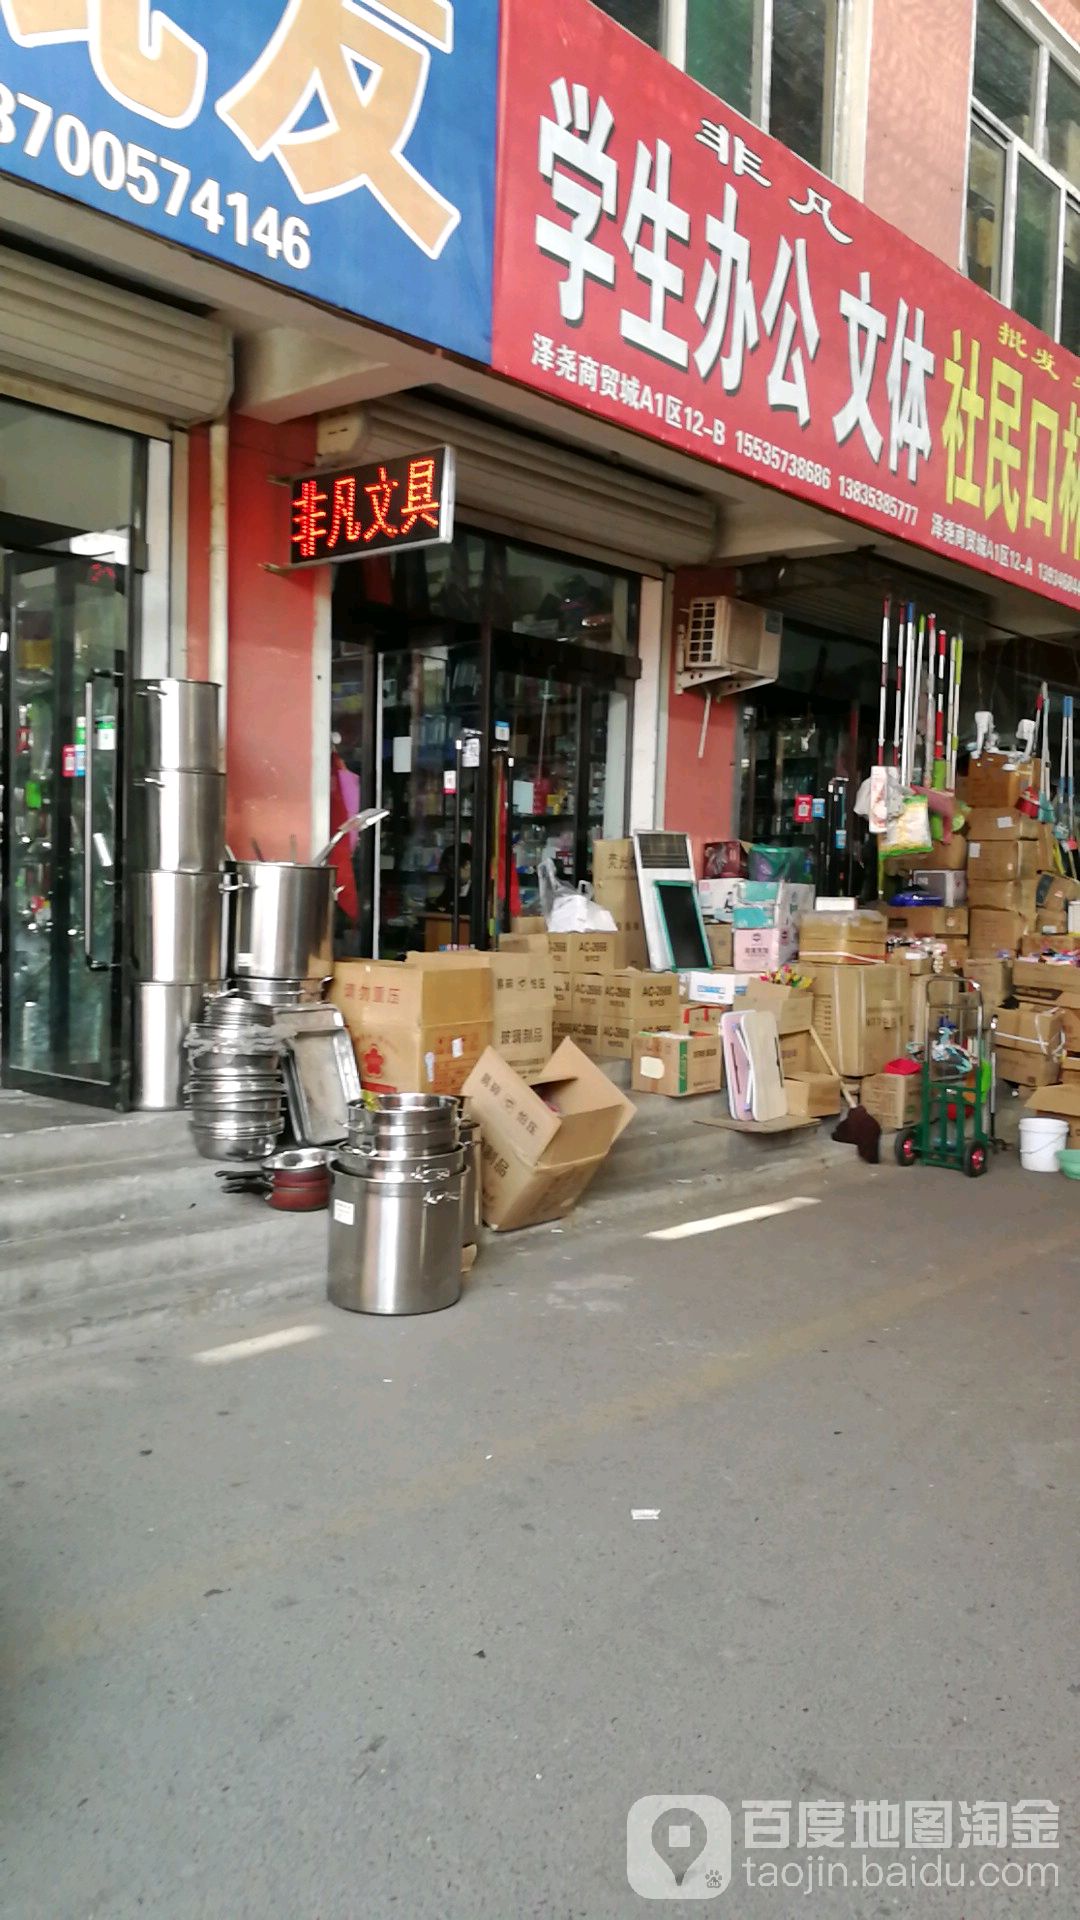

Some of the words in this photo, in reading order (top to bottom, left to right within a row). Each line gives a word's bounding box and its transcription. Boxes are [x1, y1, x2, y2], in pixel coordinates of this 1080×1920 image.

[694, 117, 854, 245] 非凡
[534, 76, 820, 428] 学生办公
[831, 271, 936, 483] 文体
[291, 459, 440, 557] 非凡文具
